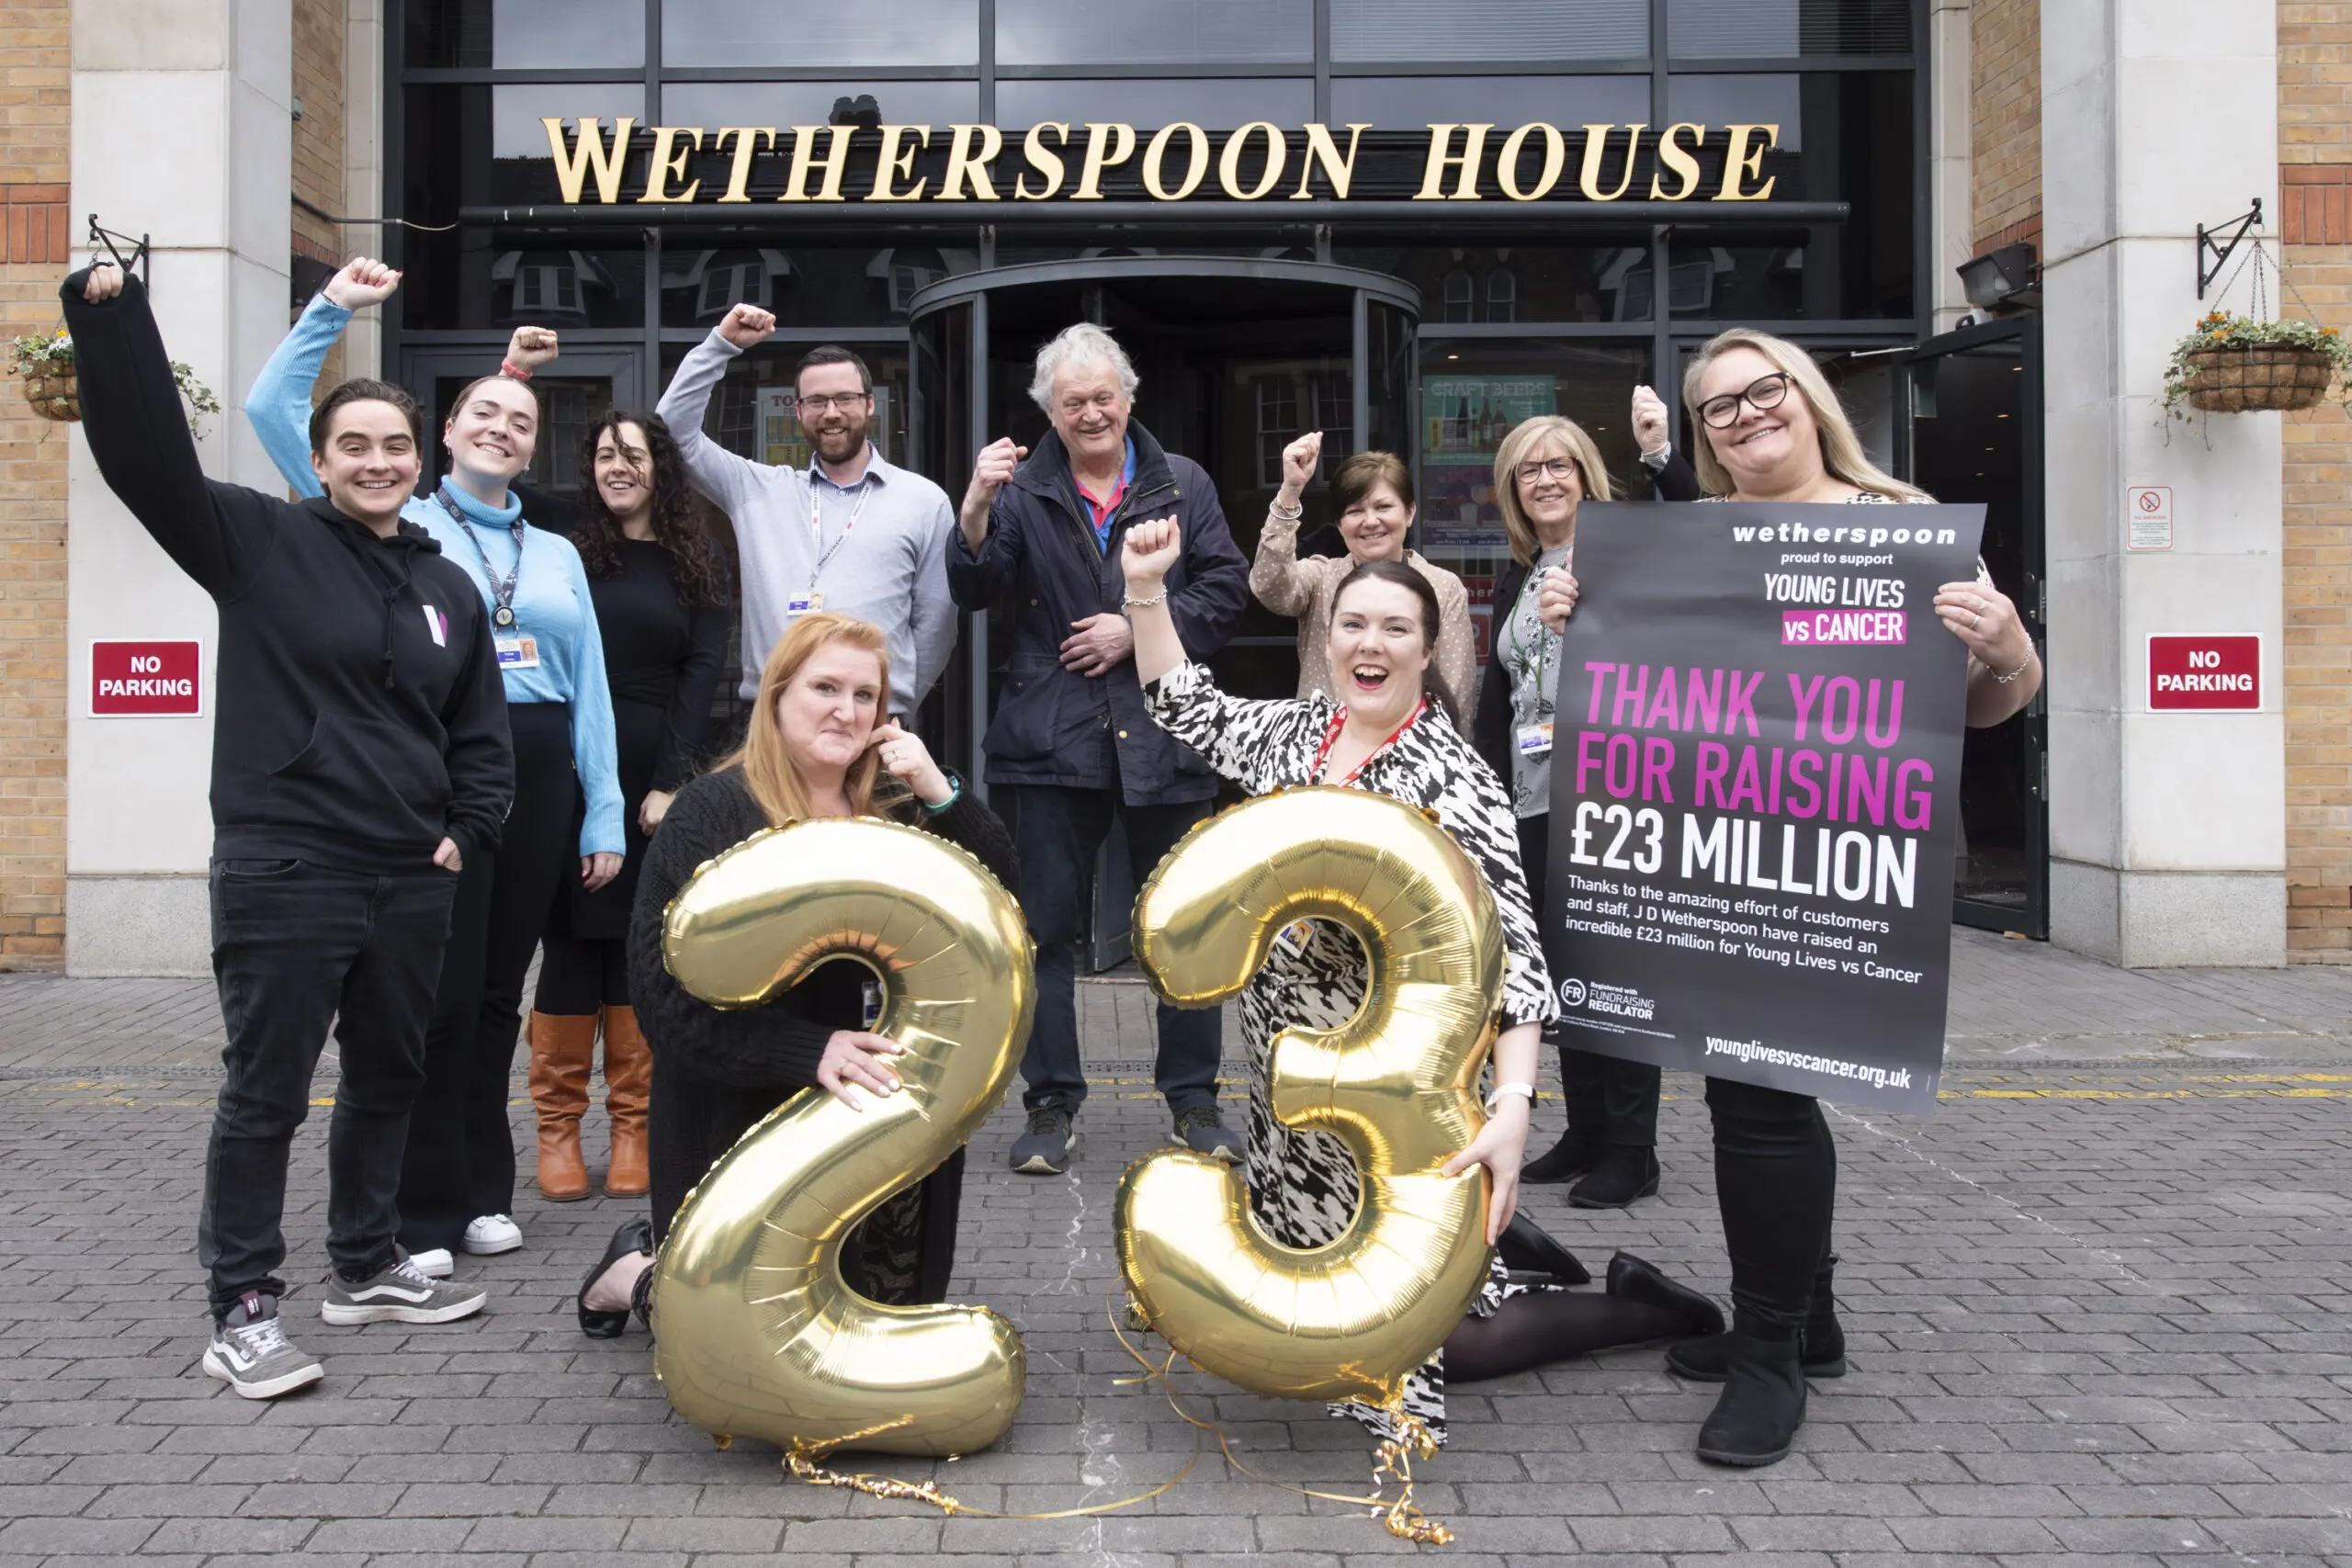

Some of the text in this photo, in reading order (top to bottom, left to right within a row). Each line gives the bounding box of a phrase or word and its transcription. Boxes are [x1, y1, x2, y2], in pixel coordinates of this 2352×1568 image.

[538, 117, 1780, 204] WETHERSPOON HOUSE
[1430, 382, 1488, 397] CRAFT
[1733, 523, 1956, 547] wetherspoon
[1781, 552, 1894, 567] proud to support
[1764, 573, 1905, 608] YOUNG LIVES
[1784, 612, 1903, 642] vs CANCER
[130, 656, 161, 672] NO
[2189, 650, 2221, 668] NO
[99, 679, 192, 696] PARKING
[2157, 673, 2253, 691] PARKING
[1585, 661, 1905, 749] THANK YOU
[1576, 730, 1934, 831] FOR RAISING
[1569, 800, 1917, 908] £23 MILLION
[1568, 874, 1890, 934] Thanks to the amazing effort of customers
[1566, 897, 1878, 954] and staff, J D Wetherspoon have raised an
[1566, 915, 1923, 984] incredible £23 million for Young Lives vs Cancer
[1565, 985, 1582, 999] FR
[1590, 981, 1623, 993] Registered
[1589, 989, 1655, 1010] FUNDRAISING
[1589, 998, 1653, 1021] REGULATOR
[1705, 1036, 1911, 1089] younglivesvscancer.org.uk
